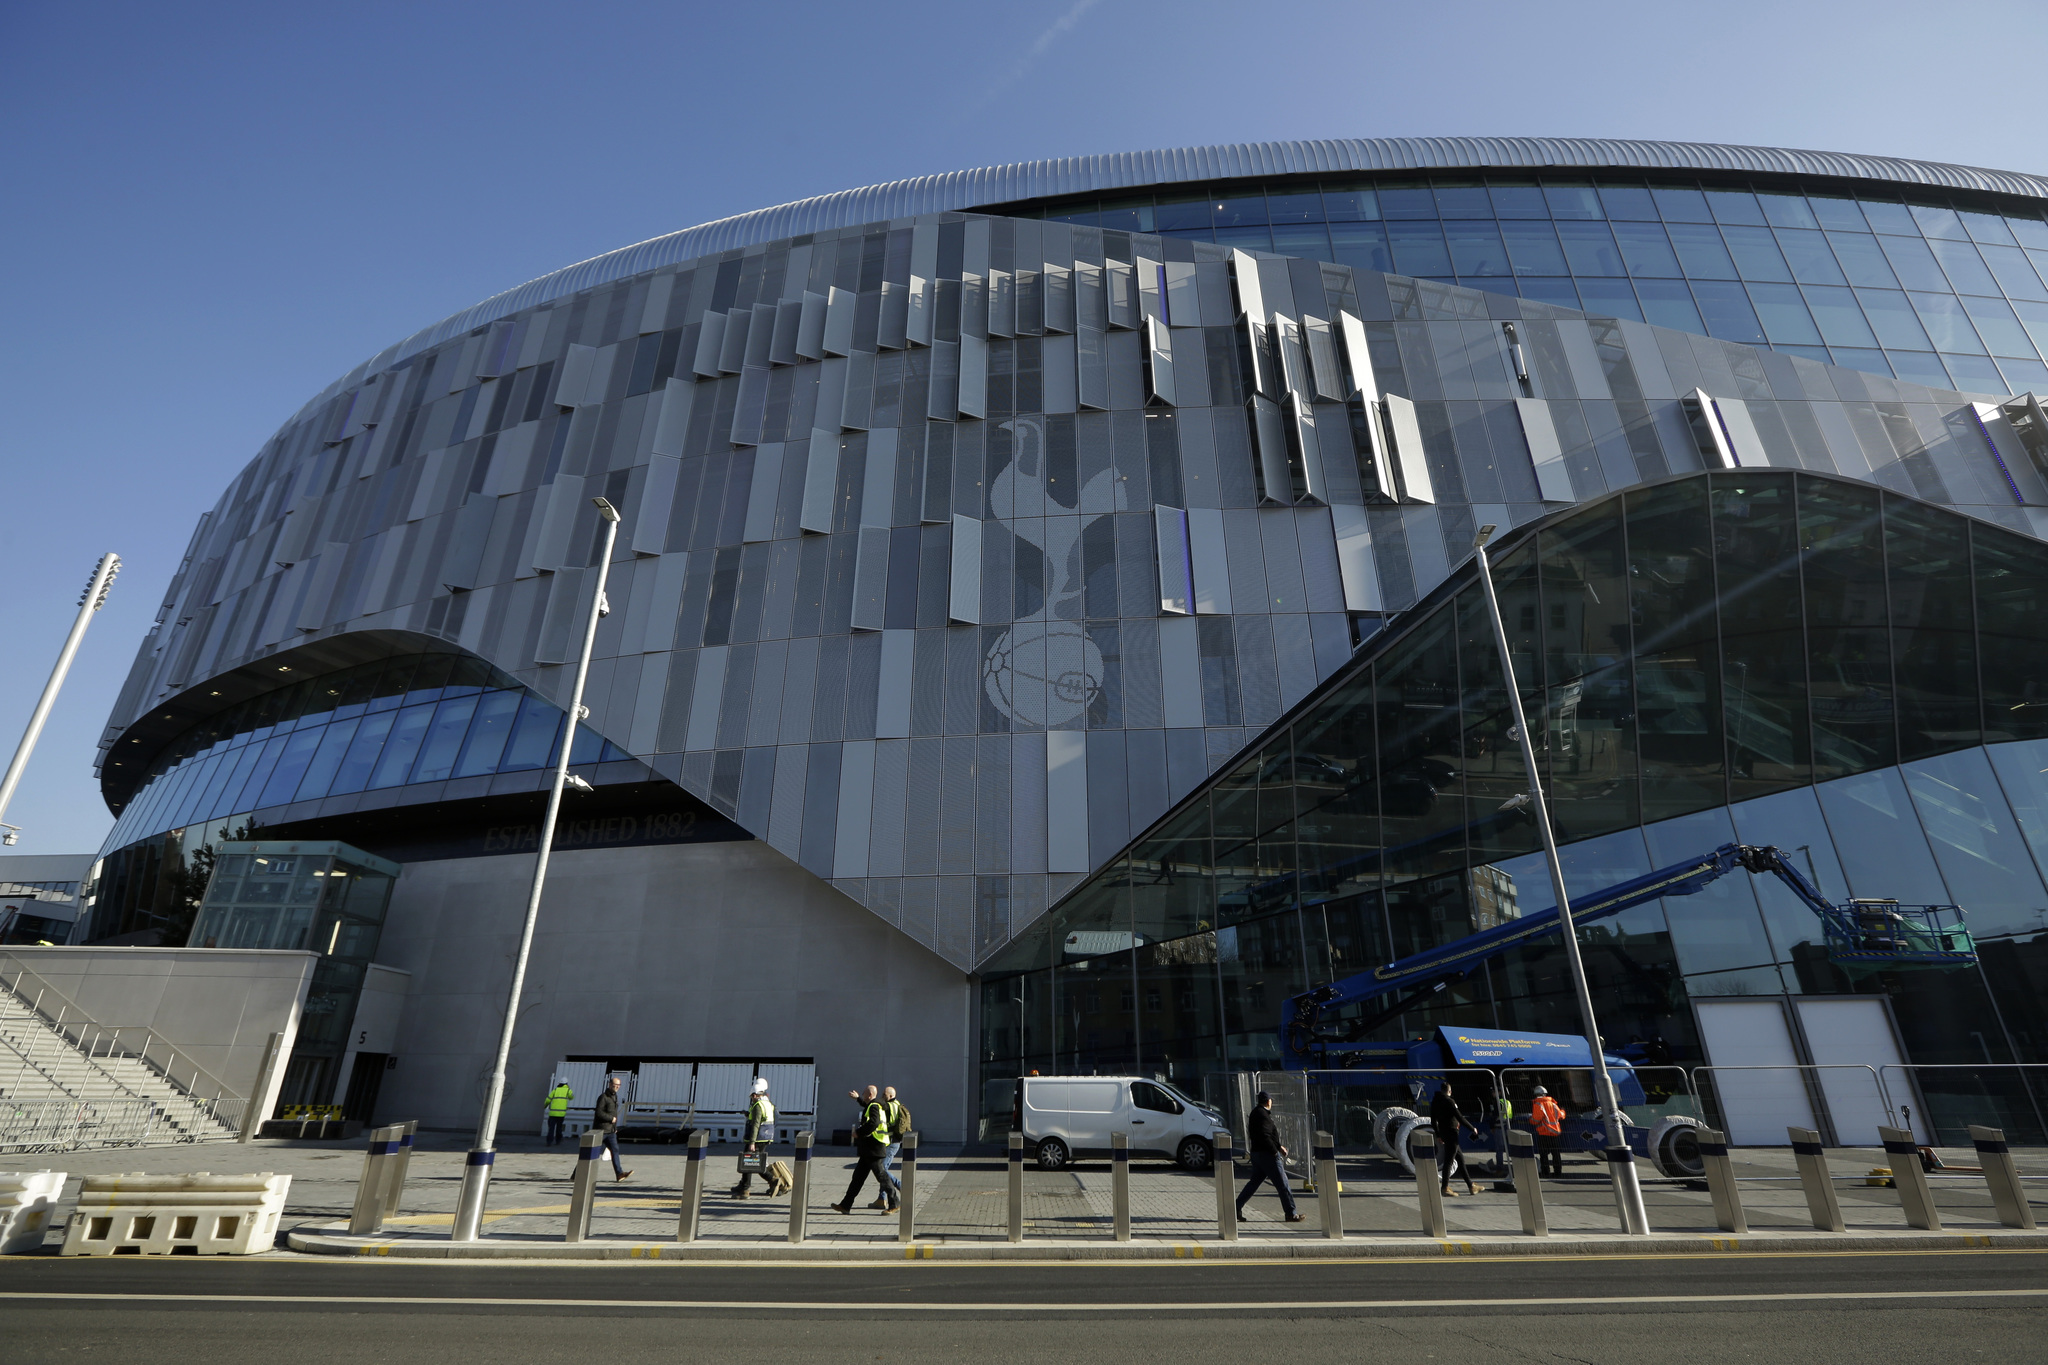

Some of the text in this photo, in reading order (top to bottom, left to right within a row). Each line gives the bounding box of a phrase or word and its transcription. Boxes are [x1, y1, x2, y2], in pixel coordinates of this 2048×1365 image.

[483, 811, 696, 852] ESTALISHED 1882
[359, 1031, 367, 1044] 5
